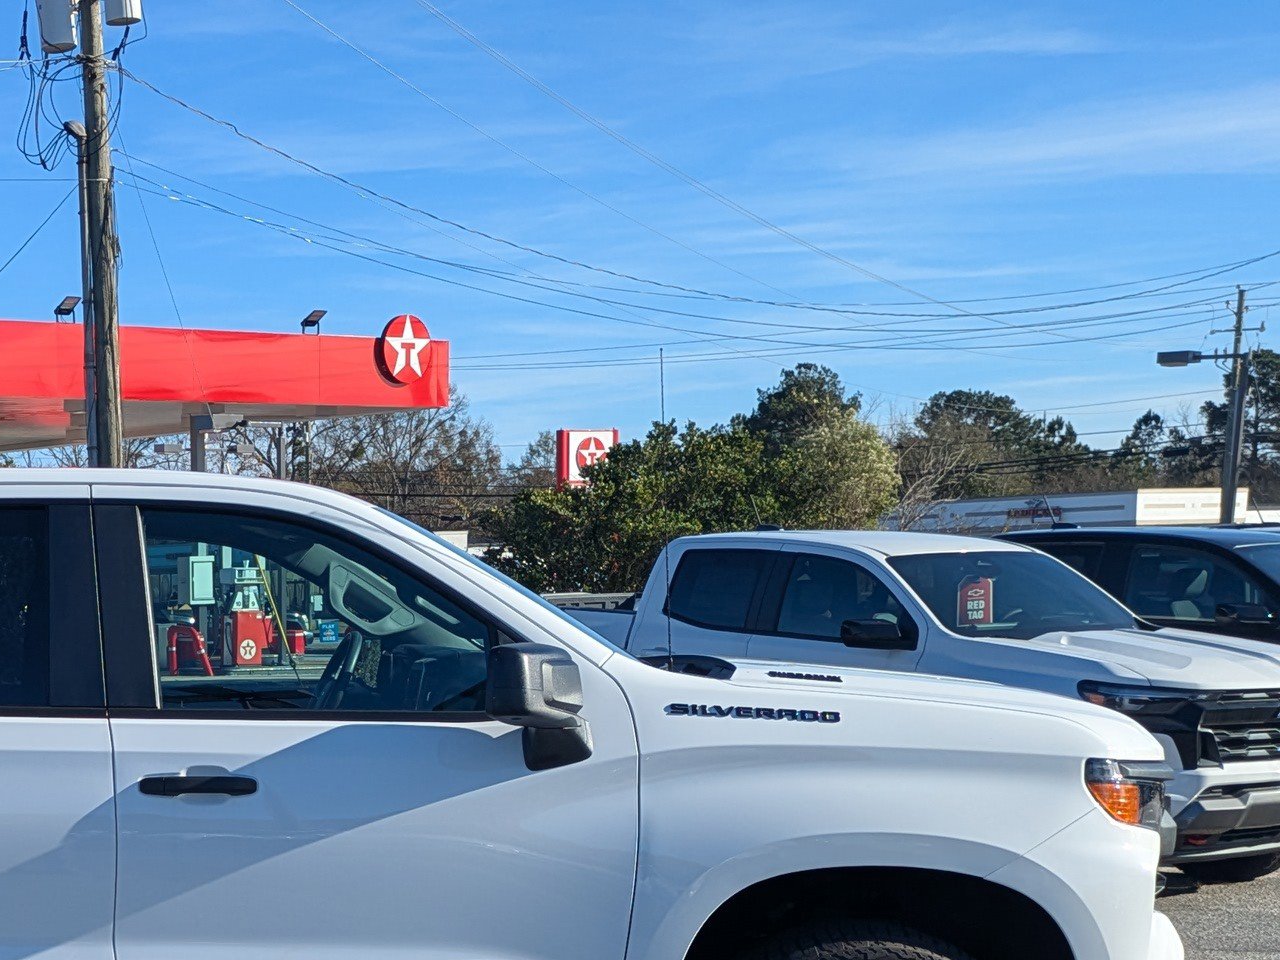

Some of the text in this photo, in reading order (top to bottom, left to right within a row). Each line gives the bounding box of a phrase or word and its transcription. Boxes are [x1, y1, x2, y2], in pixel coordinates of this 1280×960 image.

[967, 600, 985, 610] RED
[967, 610, 984, 620] TAG
[665, 703, 841, 724] SILVERADO
